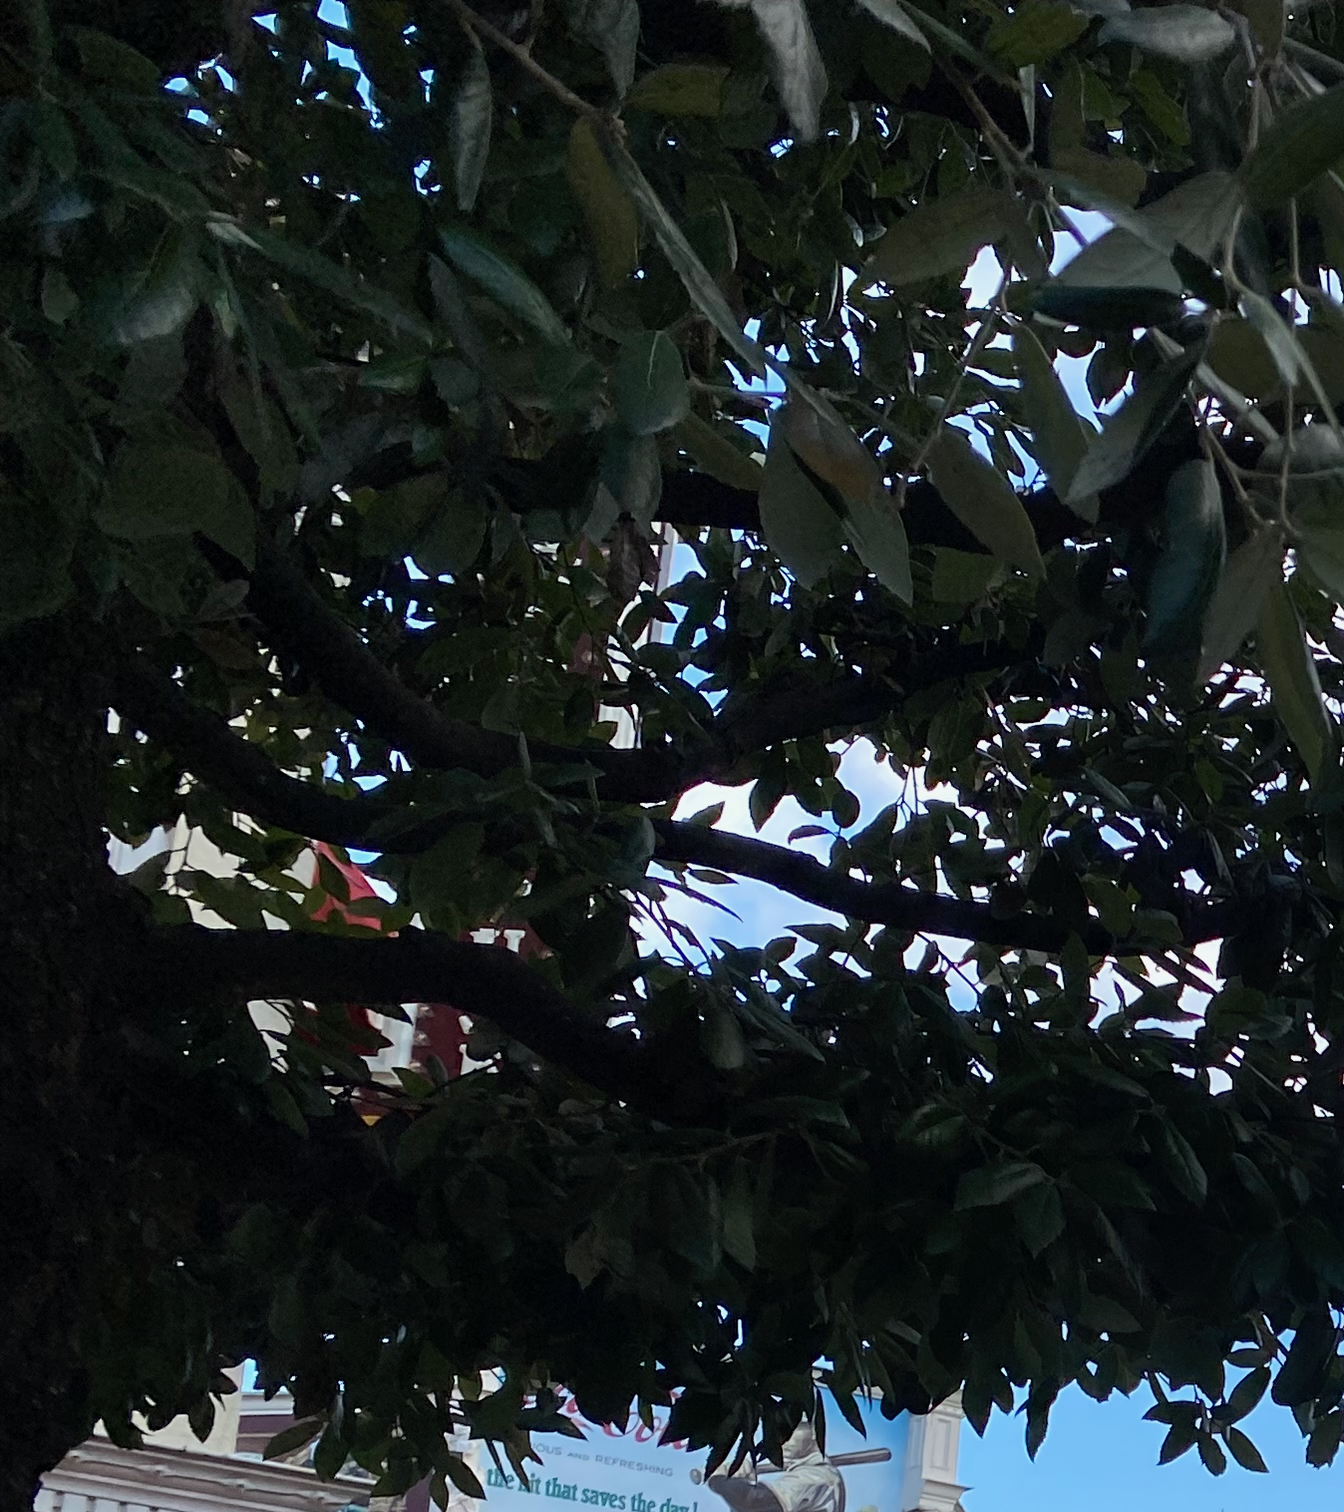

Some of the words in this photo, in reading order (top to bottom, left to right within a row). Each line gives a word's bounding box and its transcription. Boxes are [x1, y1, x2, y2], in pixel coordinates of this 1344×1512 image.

[533, 1441, 562, 1456] IOUS
[567, 1452, 590, 1462] AND
[595, 1454, 674, 1477] REFRESHING
[545, 1477, 578, 1502] that
[581, 1488, 626, 1511] saves
